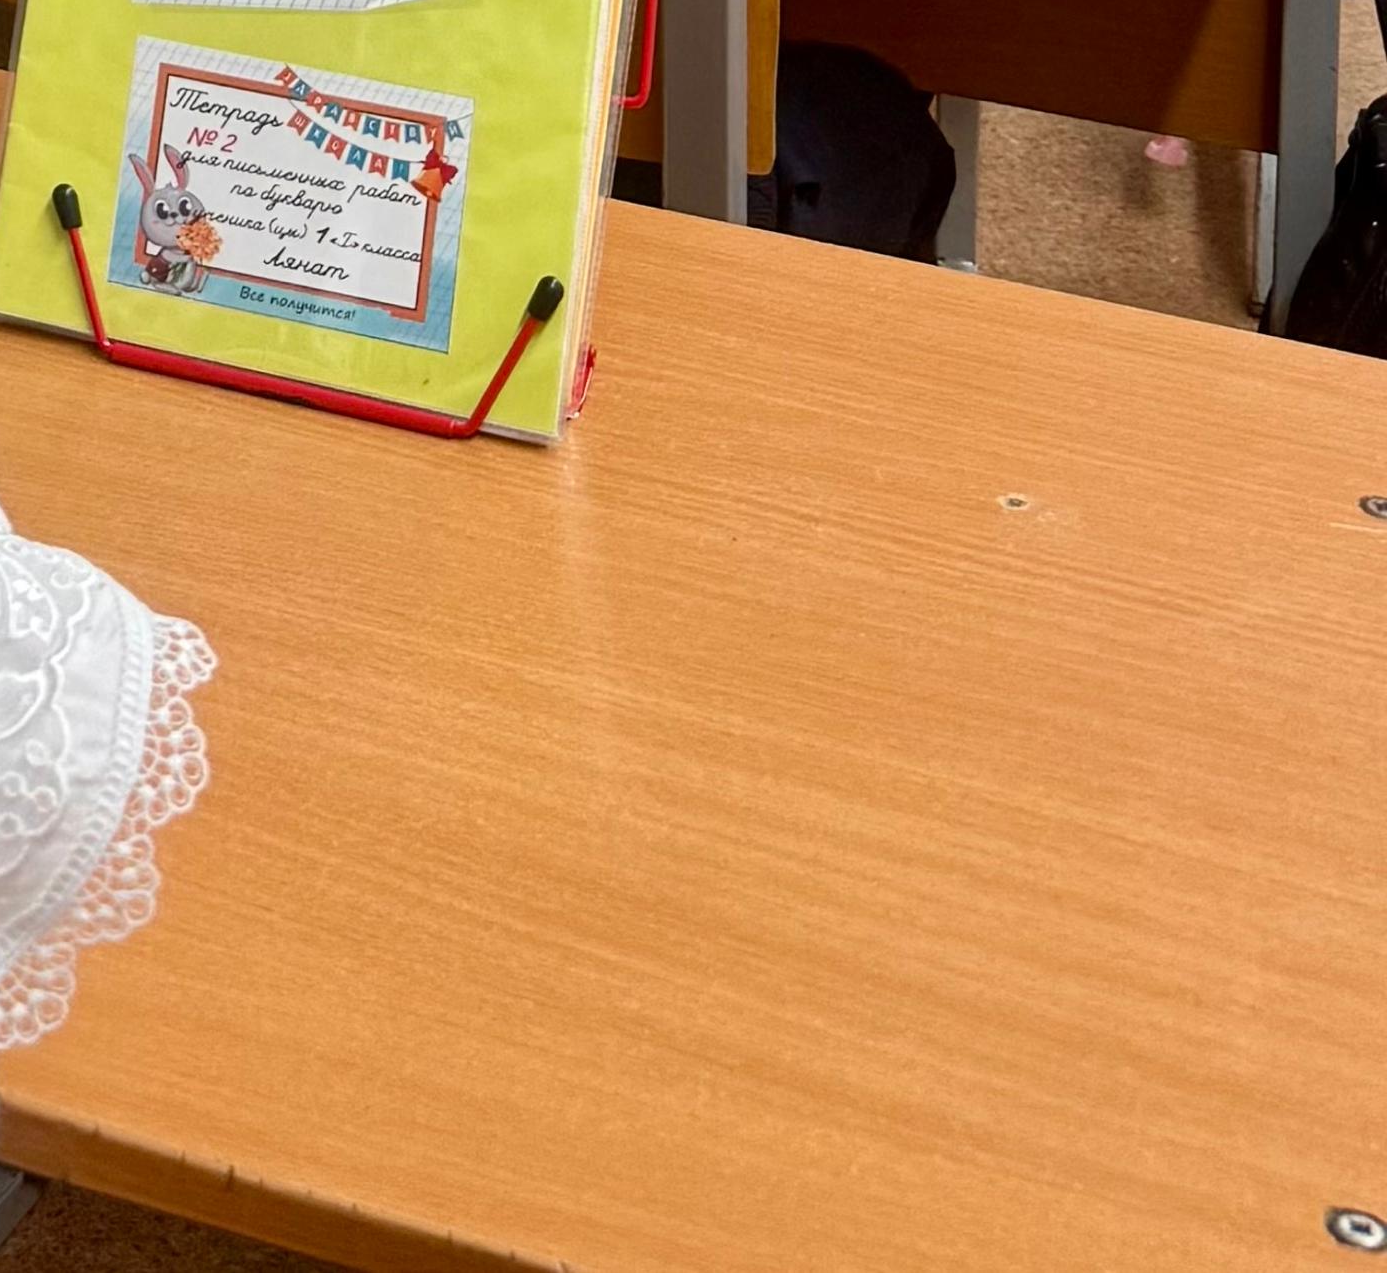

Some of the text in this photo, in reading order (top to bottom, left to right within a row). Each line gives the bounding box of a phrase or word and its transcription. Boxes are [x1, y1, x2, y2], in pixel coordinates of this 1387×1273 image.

[169, 87, 284, 136] Тетрадь
[187, 126, 238, 153] № 2
[177, 149, 422, 208] для письменных работ
[230, 181, 343, 220] по букварю
[188, 207, 265, 232] ученика
[316, 226, 330, 244] 1
[361, 242, 423, 263] класса
[239, 285, 357, 322] Все получится!
